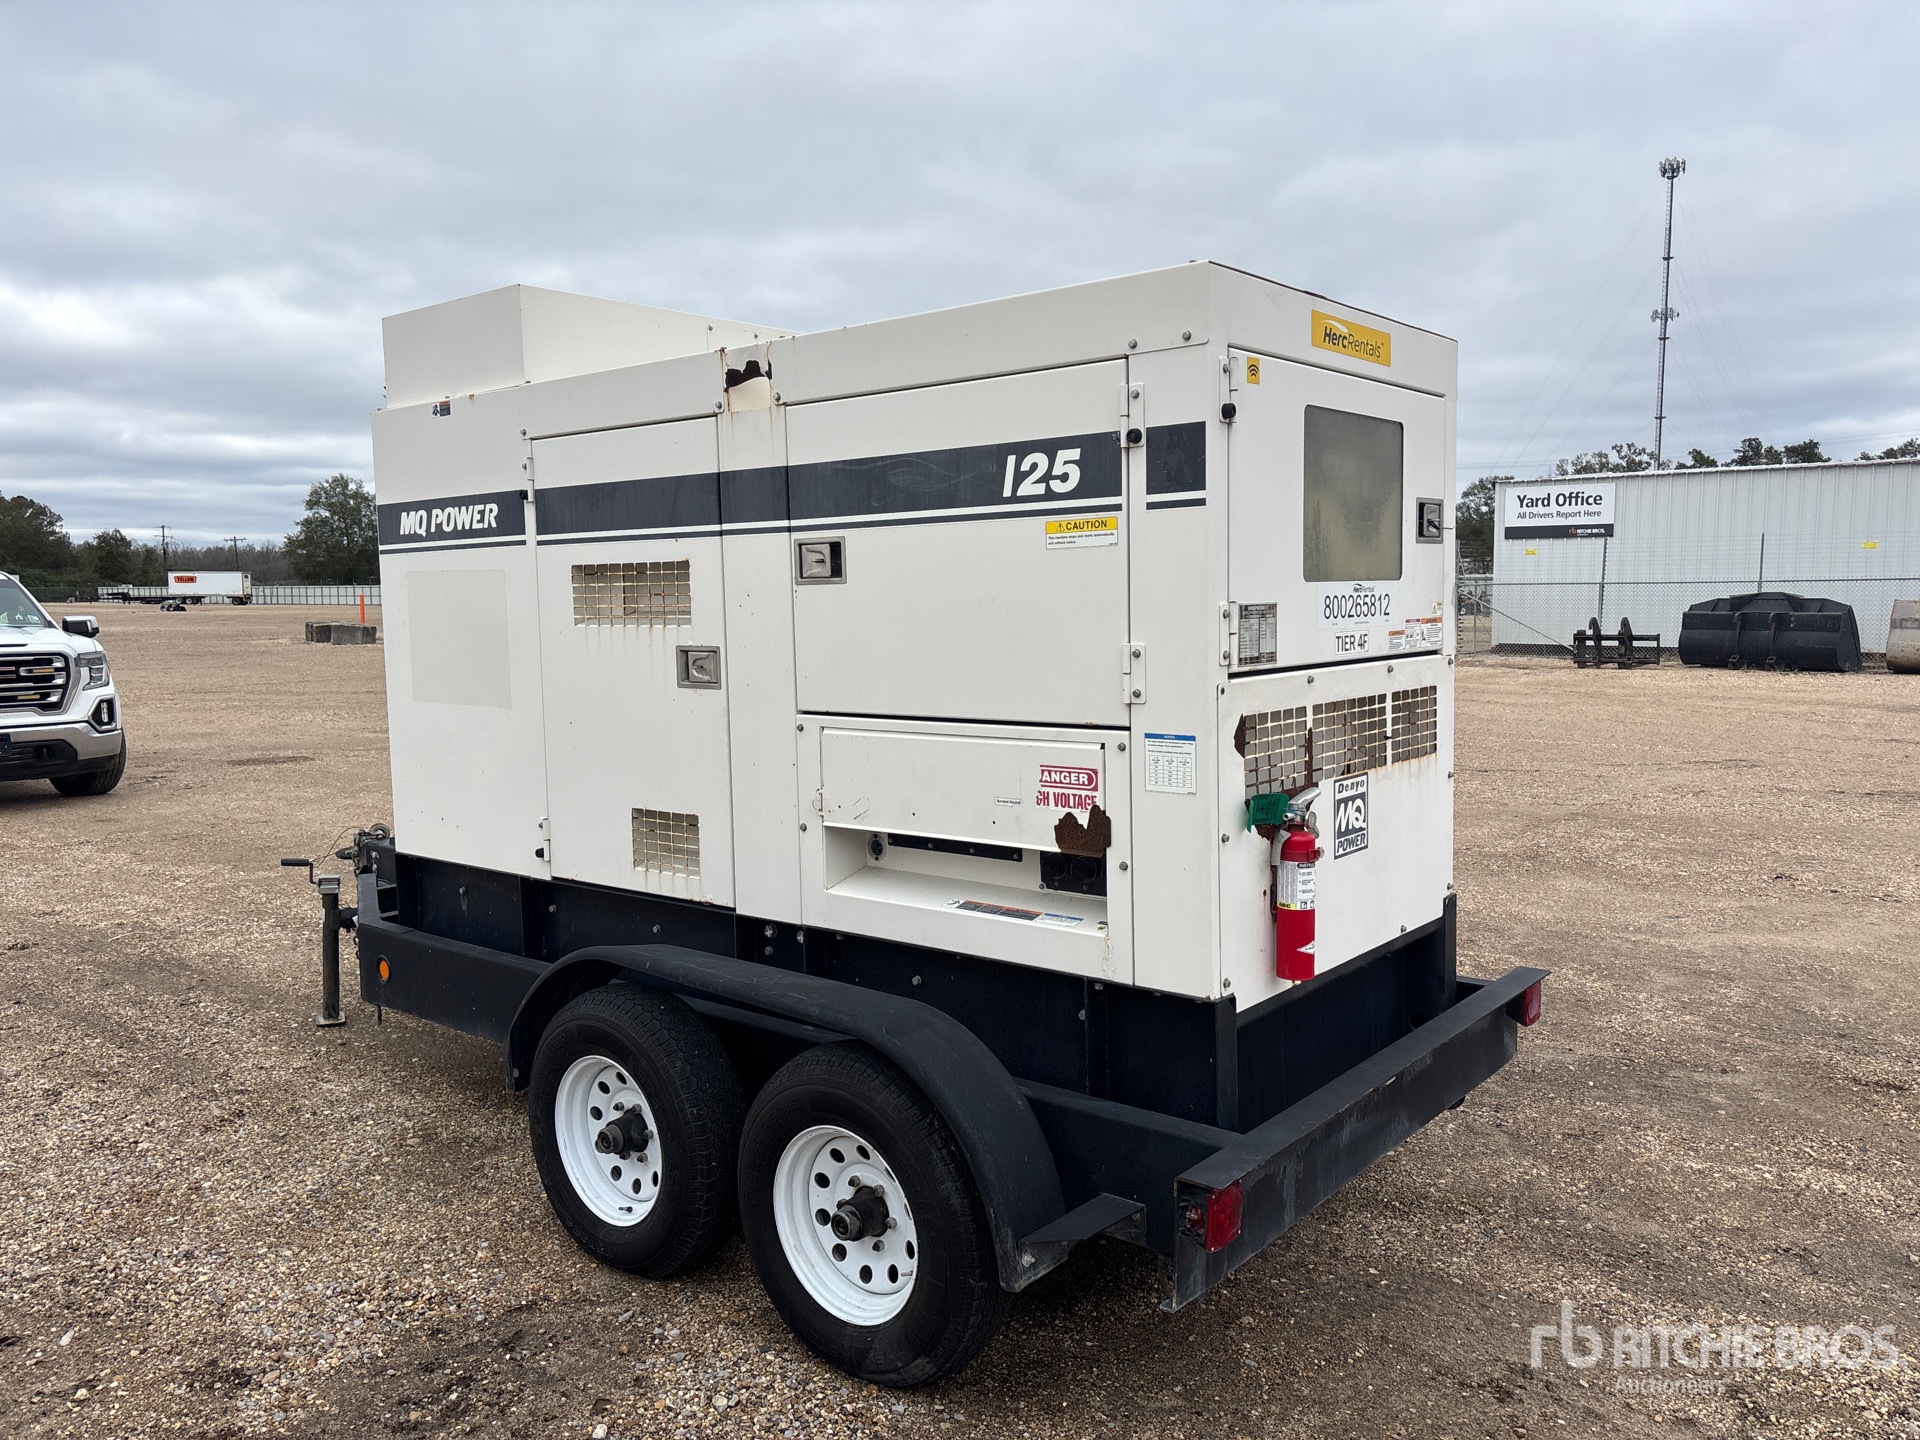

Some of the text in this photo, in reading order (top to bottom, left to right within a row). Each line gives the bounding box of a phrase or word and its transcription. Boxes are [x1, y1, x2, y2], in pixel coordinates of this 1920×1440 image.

[1323, 326, 1381, 358] HercRentals
[1003, 448, 1081, 497] 125
[1517, 491, 1603, 508] Yard Office
[400, 503, 498, 537] MQ POWER
[1066, 519, 1107, 531] CAUTION
[1529, 511, 1554, 519] Drivers
[1556, 510, 1581, 519] Report
[1584, 509, 1602, 518] Here
[1323, 593, 1391, 619] 800265812
[1336, 634, 1368, 653] TIER 4F
[1338, 779, 1365, 794] Denyo
[1336, 798, 1367, 833] MQ
[1337, 832, 1366, 854] POWER
